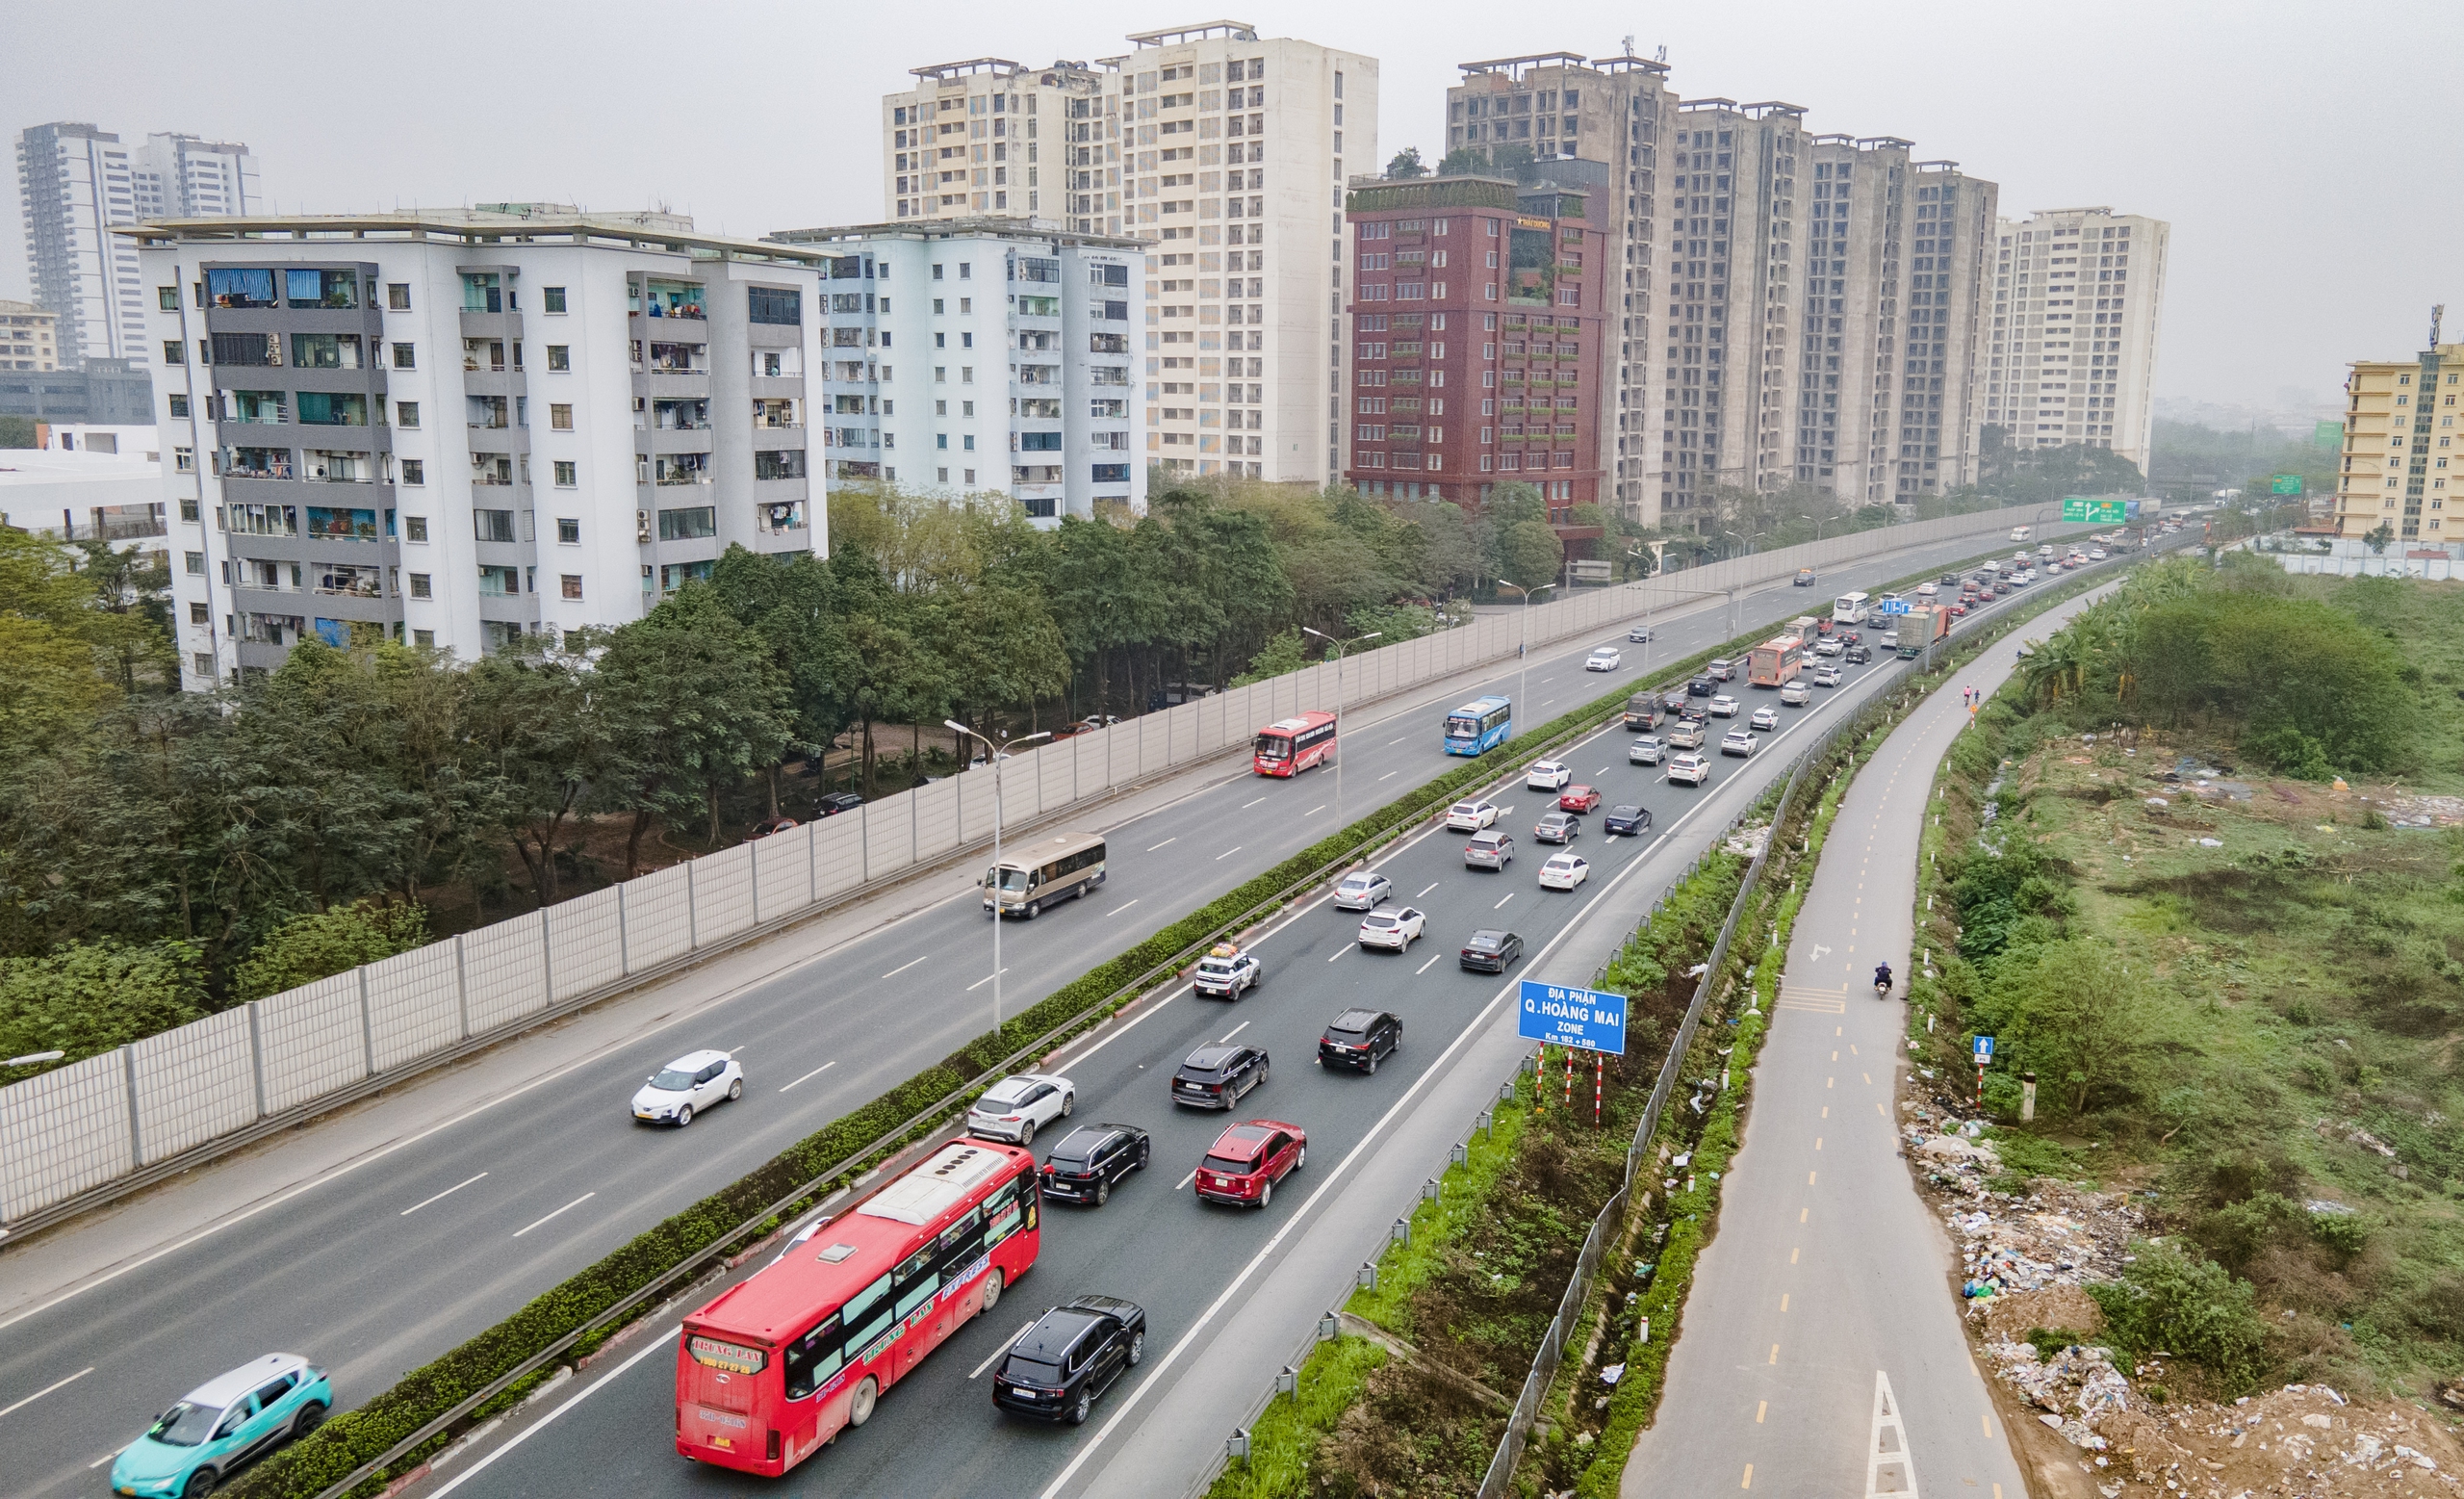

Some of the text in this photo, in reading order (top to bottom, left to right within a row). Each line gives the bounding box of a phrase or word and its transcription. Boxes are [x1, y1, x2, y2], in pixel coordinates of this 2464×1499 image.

[1548, 987, 1596, 1006] ĐỊA PHẬN
[1594, 1010, 1619, 1026] MAI
[1545, 1032, 1558, 1041] Km
[1557, 1021, 1583, 1035] ZONE
[942, 1255, 989, 1300] EXPRESS
[693, 1339, 761, 1362] TRUNG LAN
